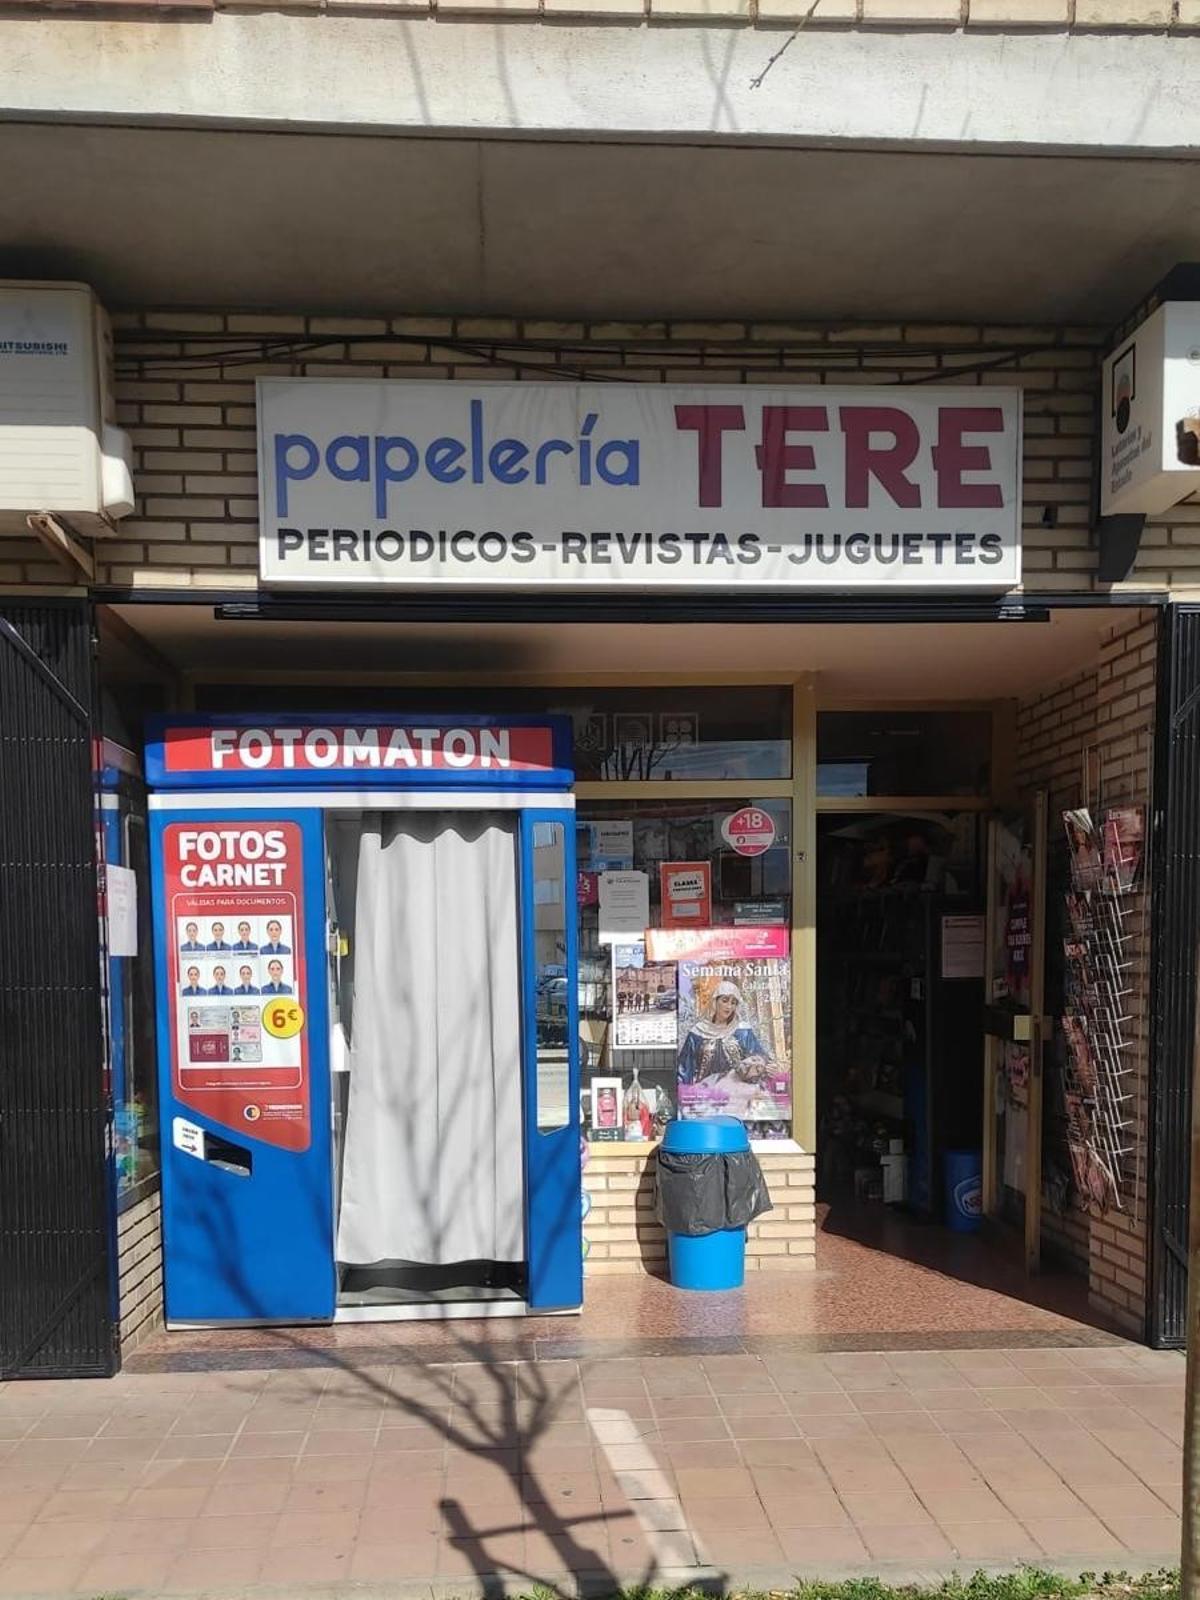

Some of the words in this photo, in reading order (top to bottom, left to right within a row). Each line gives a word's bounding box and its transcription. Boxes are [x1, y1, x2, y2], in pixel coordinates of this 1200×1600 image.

[276, 399, 641, 519] papelería
[674, 404, 1005, 509] TERE
[211, 728, 511, 769] FOTOMATON
[736, 812, 763, 829] +18
[178, 831, 287, 861] FOTOS
[180, 863, 287, 887] CARNET
[236, 897, 287, 905] DOCUMENTOS
[682, 963, 742, 978] Semana
[745, 961, 787, 977] Santa
[271, 1008, 298, 1029] 6€
